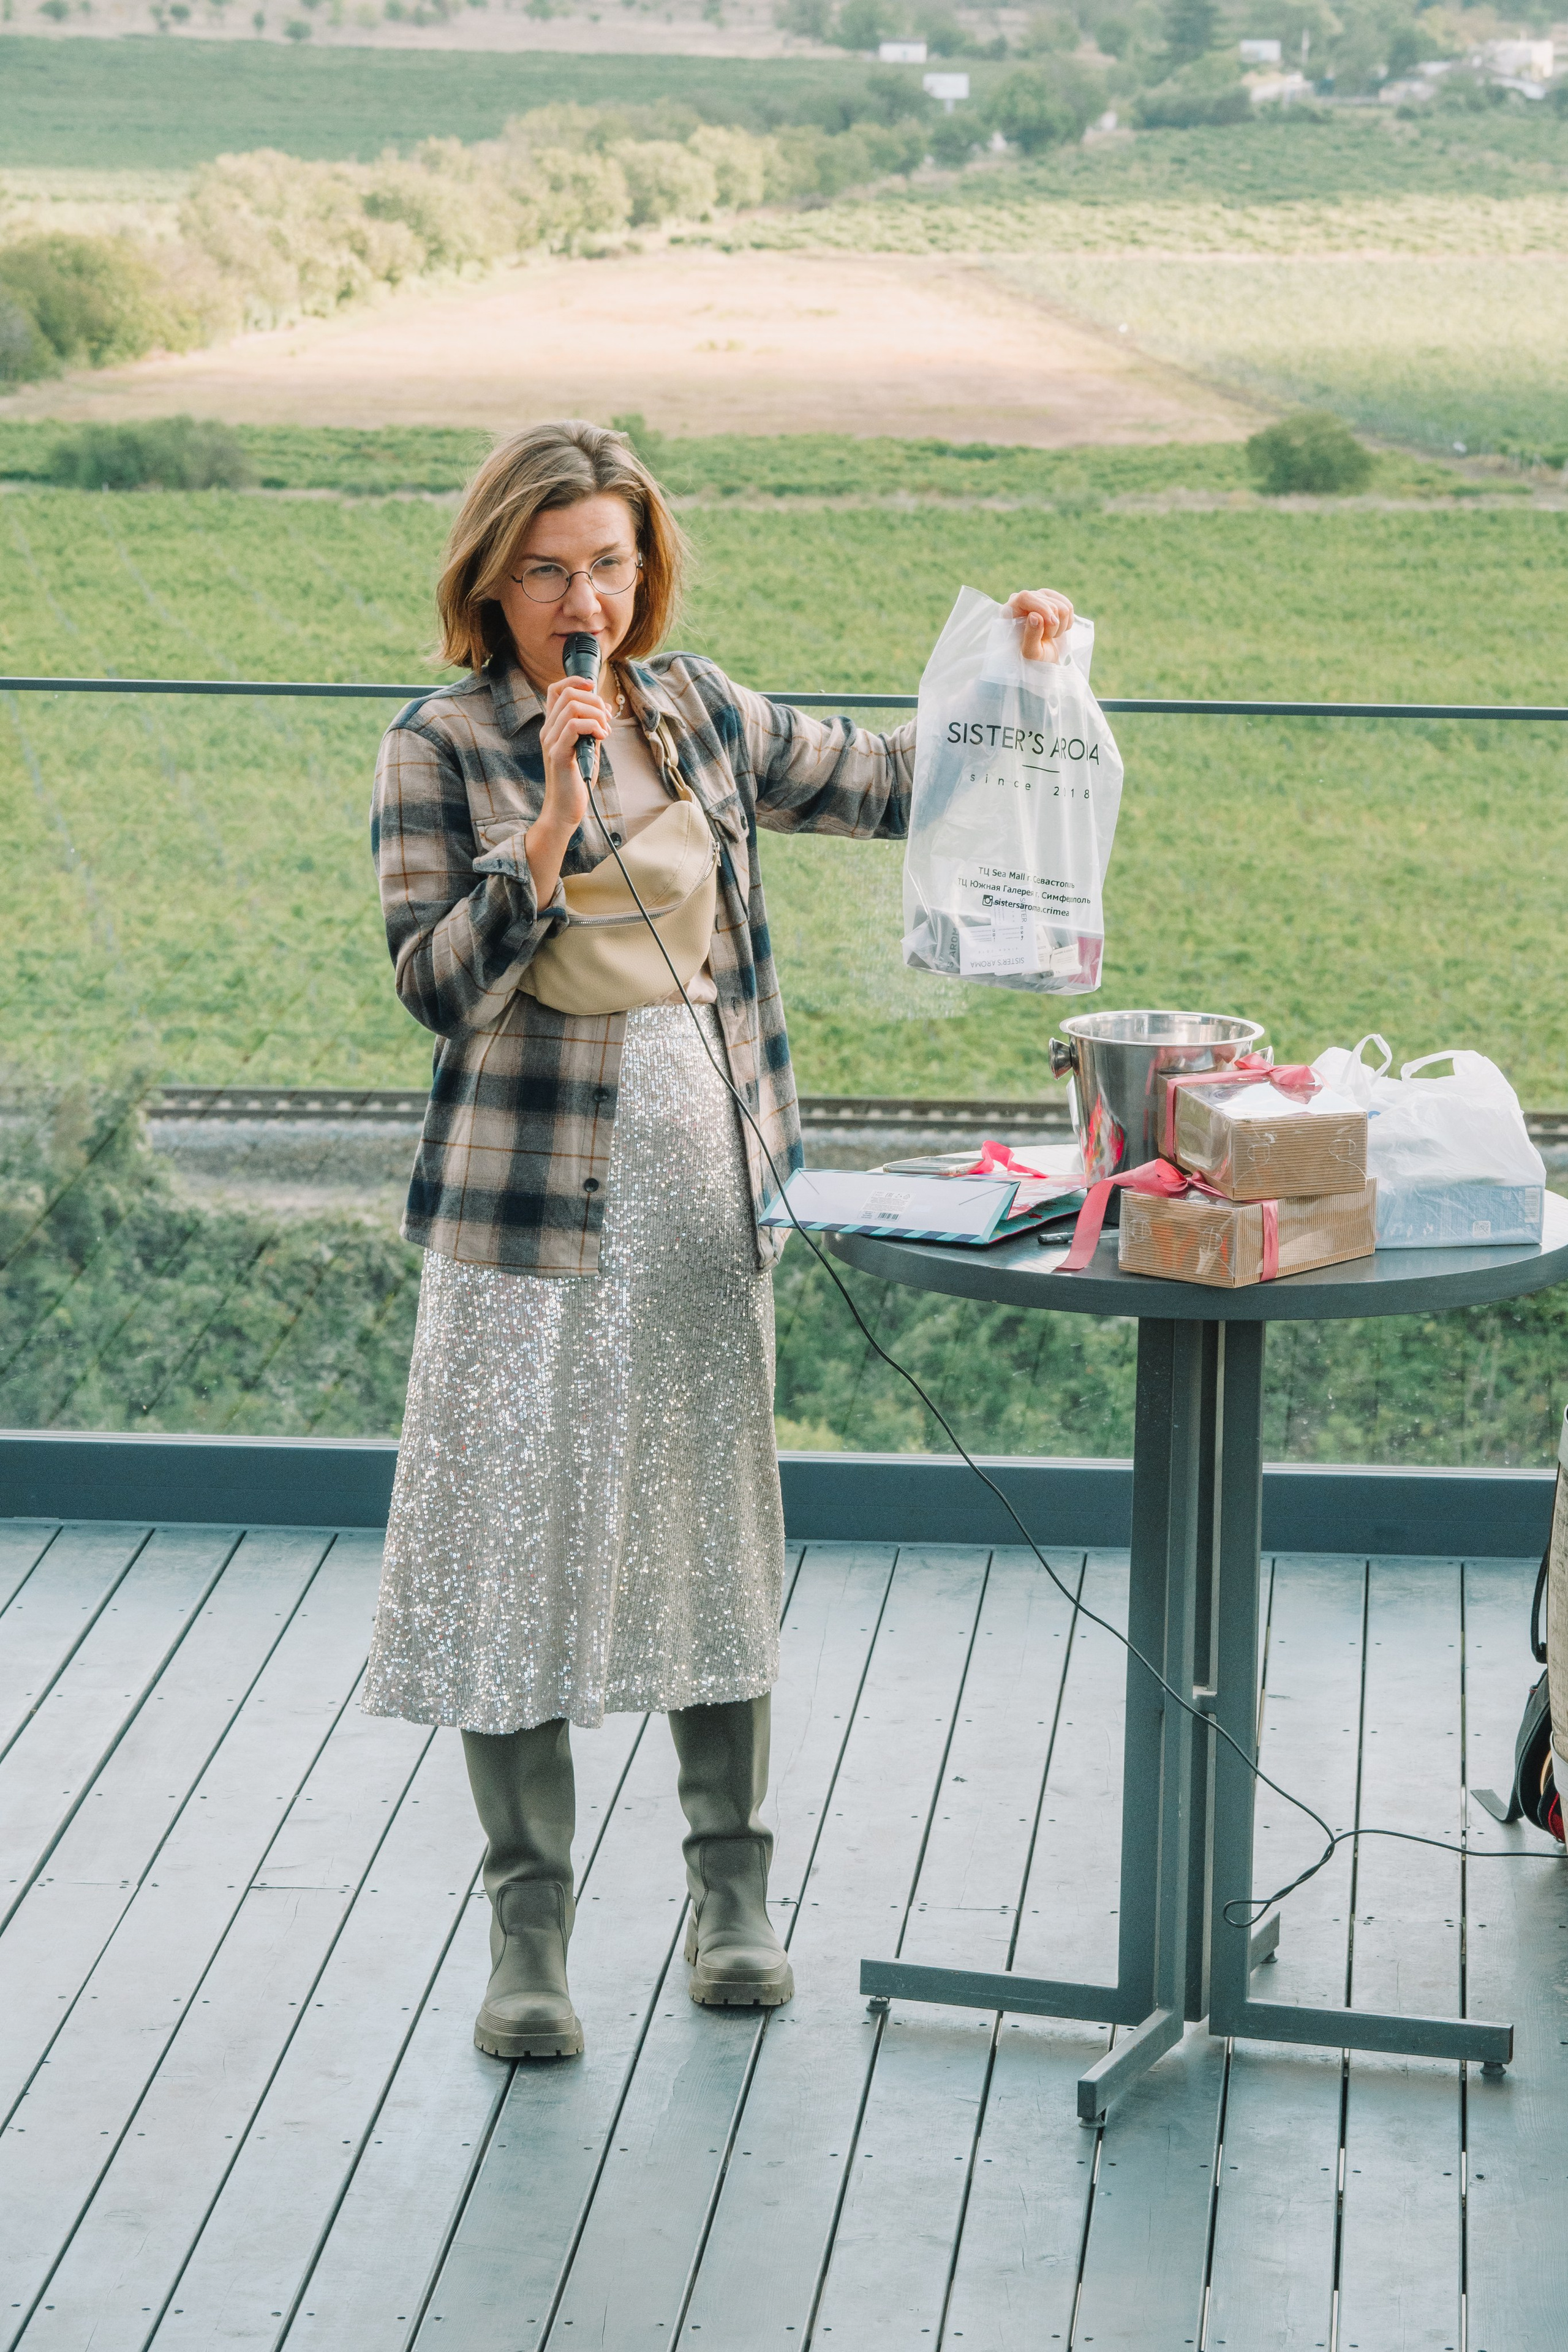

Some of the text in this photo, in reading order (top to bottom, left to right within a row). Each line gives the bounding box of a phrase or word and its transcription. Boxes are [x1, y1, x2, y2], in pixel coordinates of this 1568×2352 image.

[947, 722, 1099, 766] SISTER'S AROA
[970, 774, 1031, 791] since
[978, 867, 990, 876] ТЦ
[992, 869, 1006, 878] Sea
[1009, 871, 1025, 881] Mall
[958, 878, 967, 888] ТЦ
[970, 880, 1001, 891] Южная
[1003, 884, 1034, 896] Галерея
[994, 898, 1069, 916] sistersaroma.crimea
[970, 957, 1025, 968] SISTER'S AROMA
